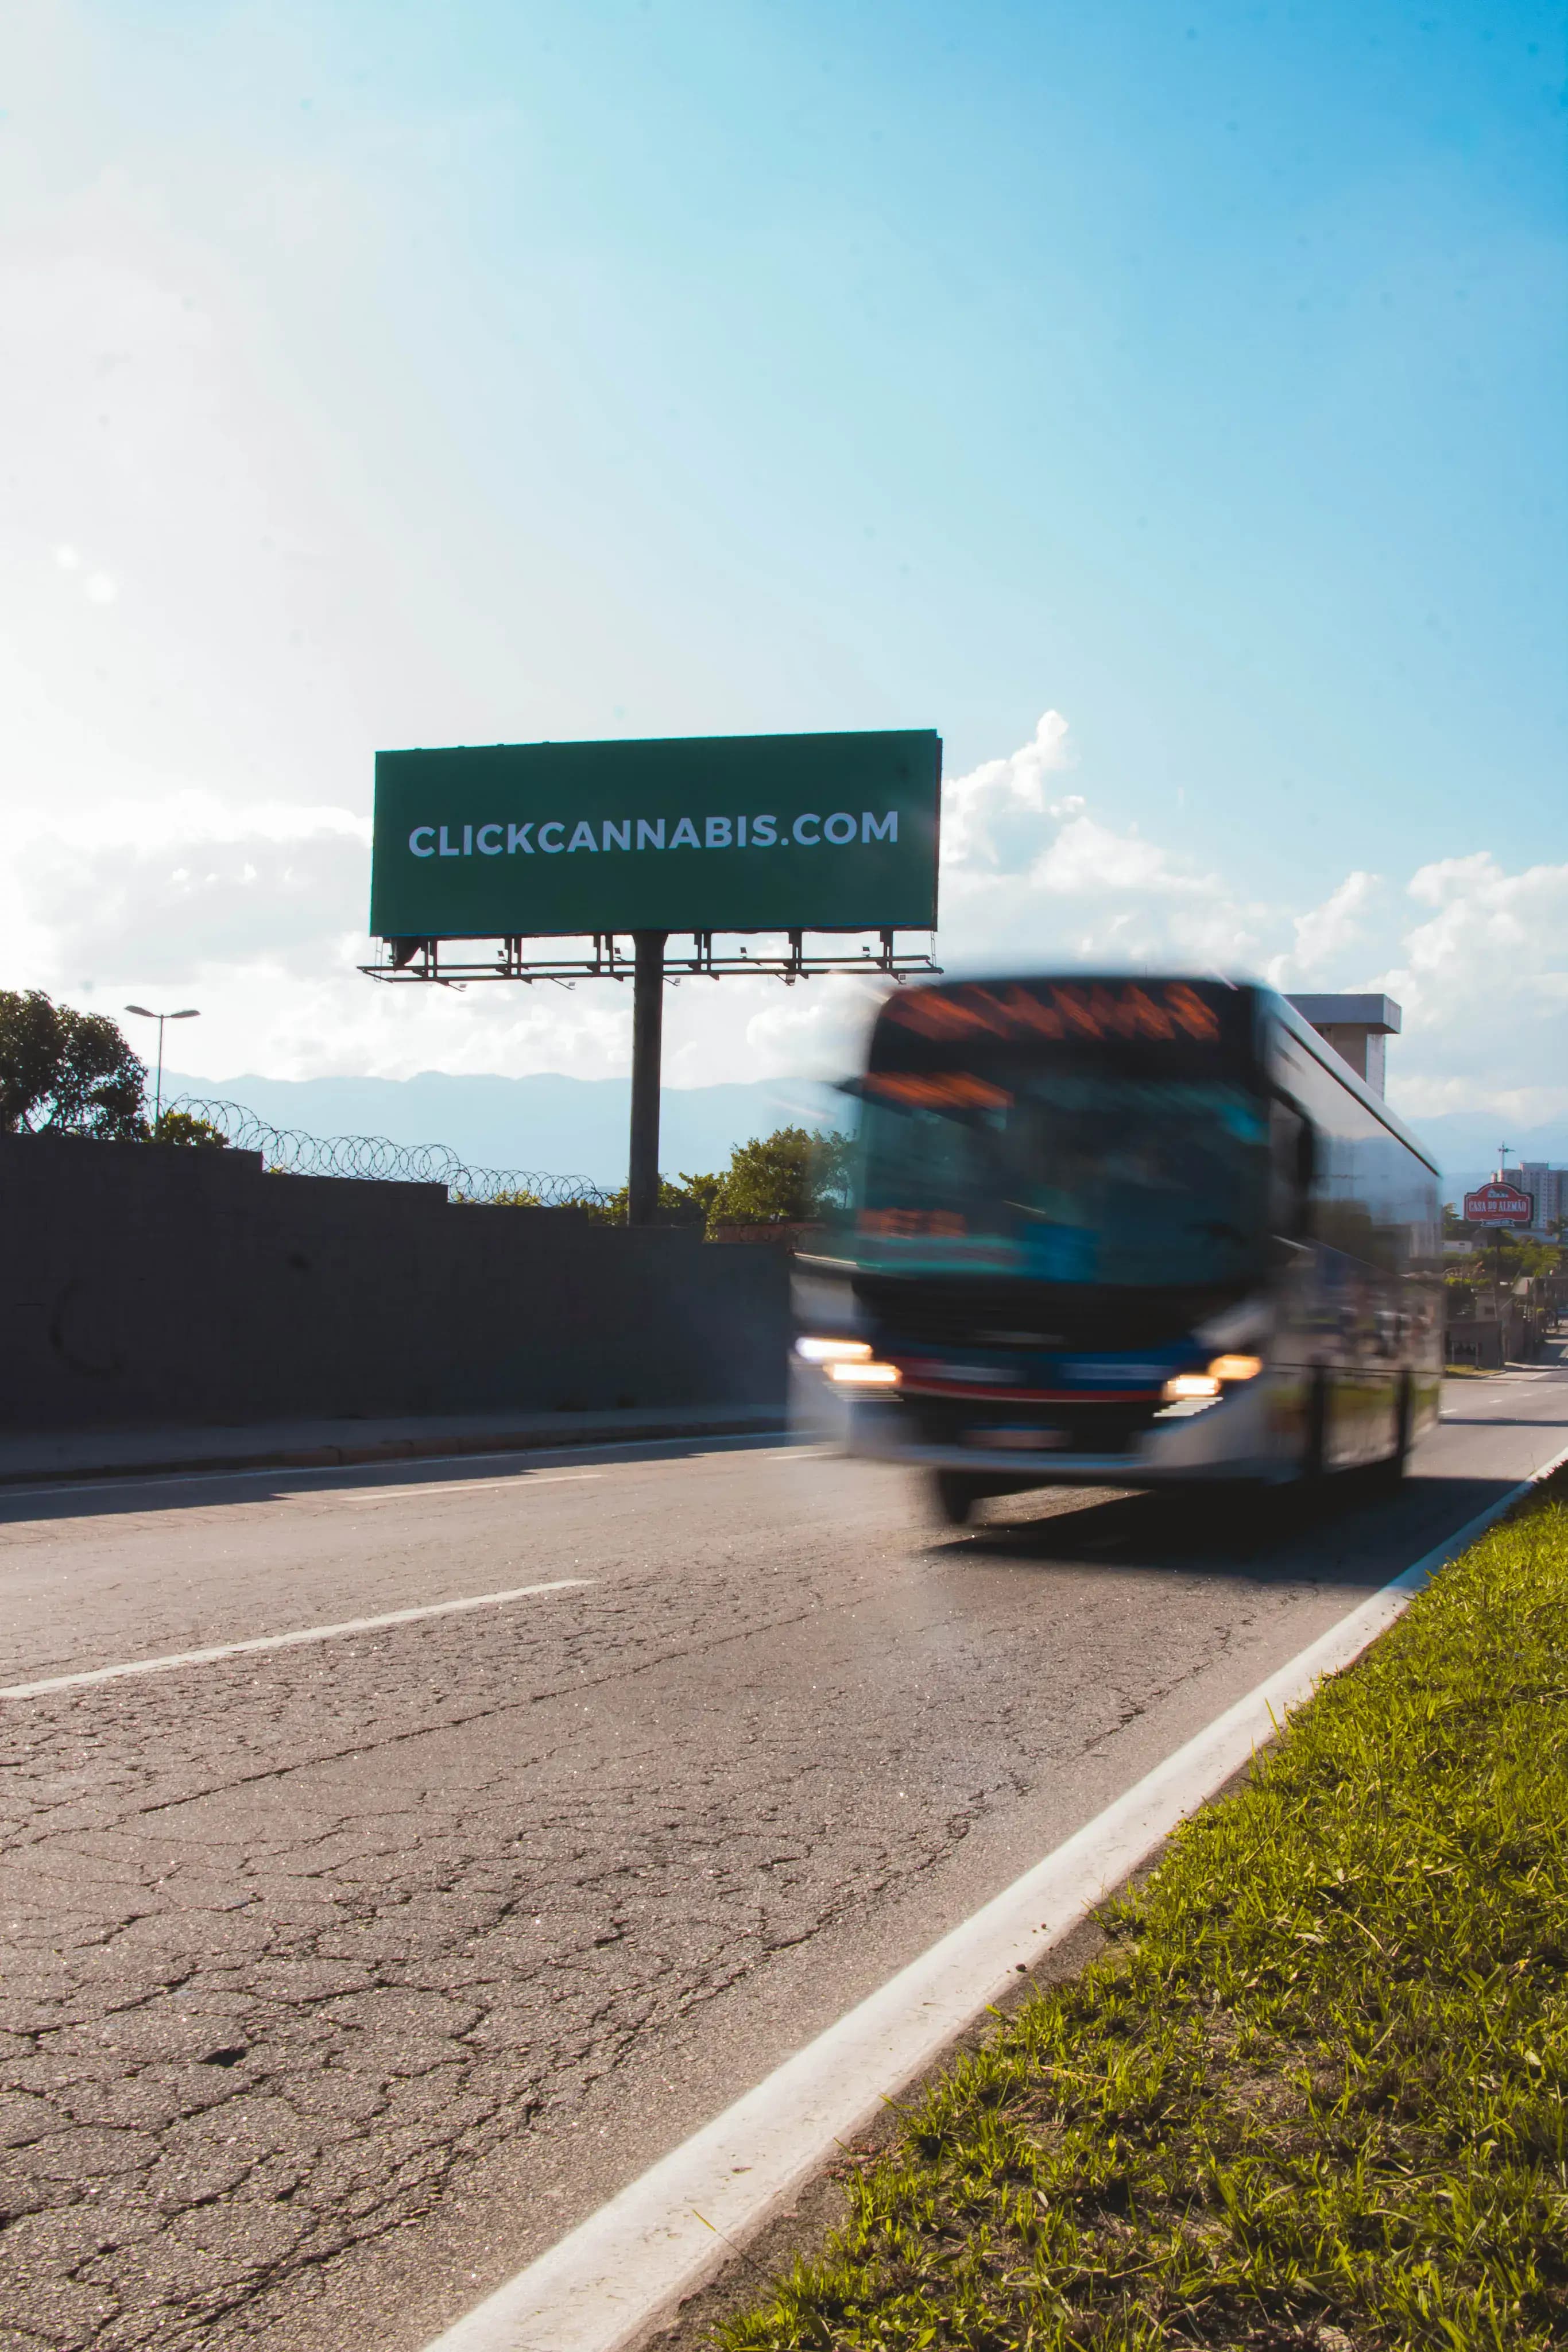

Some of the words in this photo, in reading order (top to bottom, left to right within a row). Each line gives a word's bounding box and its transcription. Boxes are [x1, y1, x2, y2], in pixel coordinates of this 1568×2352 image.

[409, 811, 898, 856] CLICKCANNABIS.COM
[1469, 1201, 1486, 1212] CASA
[1488, 1201, 1497, 1209] DO
[1499, 1199, 1527, 1212] ALEMÃO
